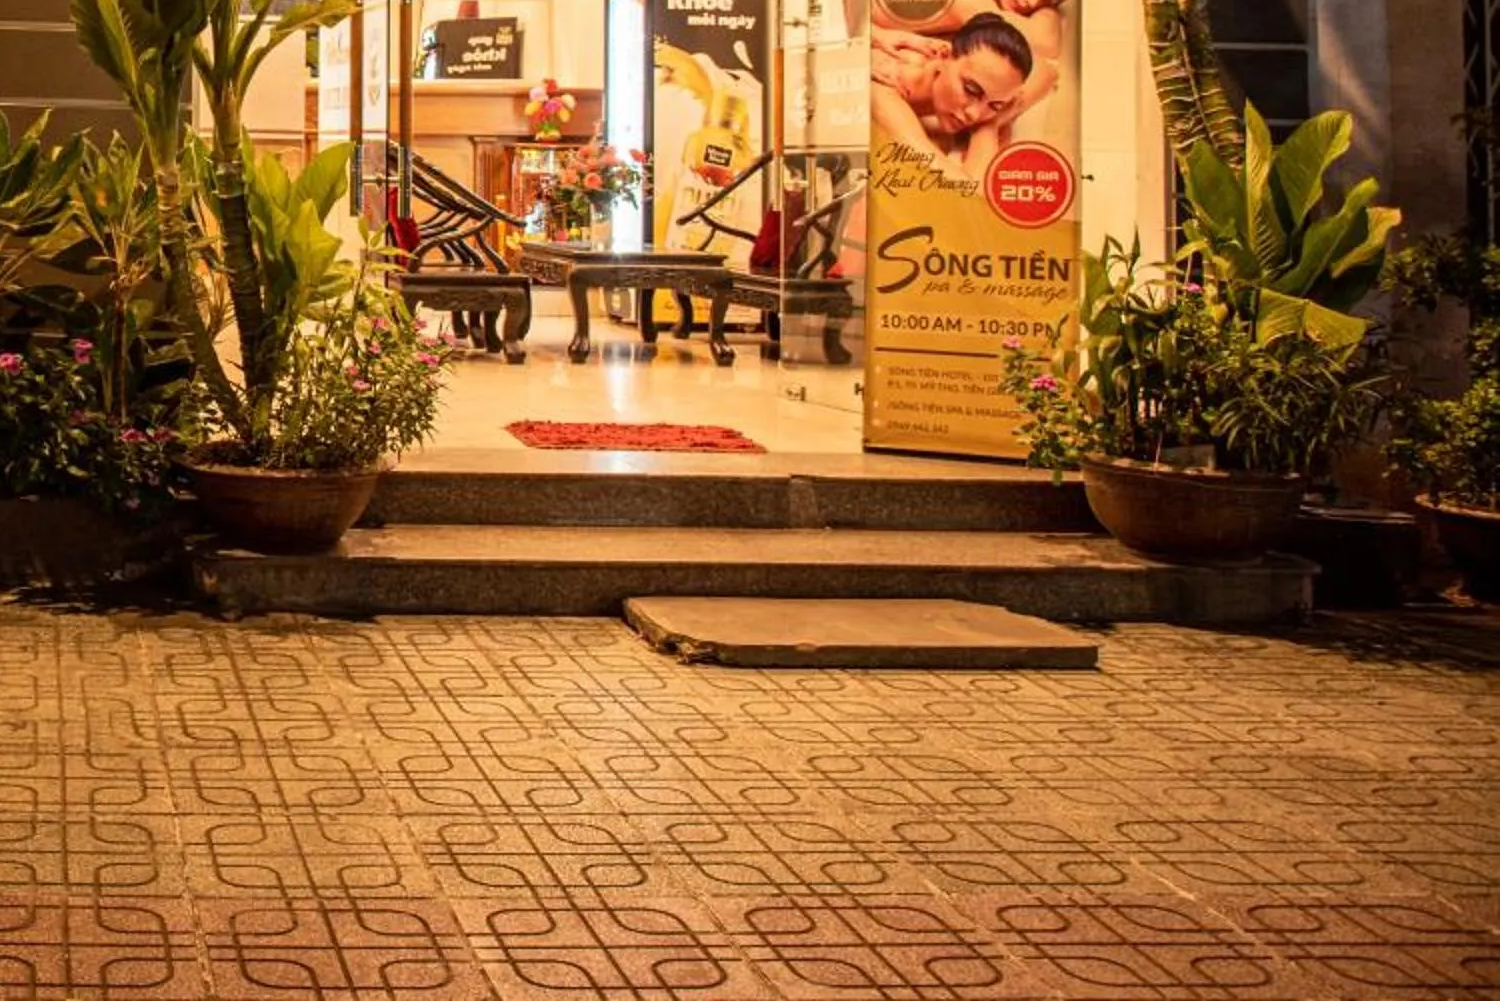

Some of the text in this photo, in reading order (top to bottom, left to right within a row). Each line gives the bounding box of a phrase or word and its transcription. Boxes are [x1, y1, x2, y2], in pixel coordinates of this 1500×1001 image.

[1000, 183, 1057, 203] 20%
[876, 225, 993, 294] SÔNG
[880, 314, 929, 331] 10:00
[931, 317, 962, 333] AM
[979, 319, 1029, 337] 10:30
